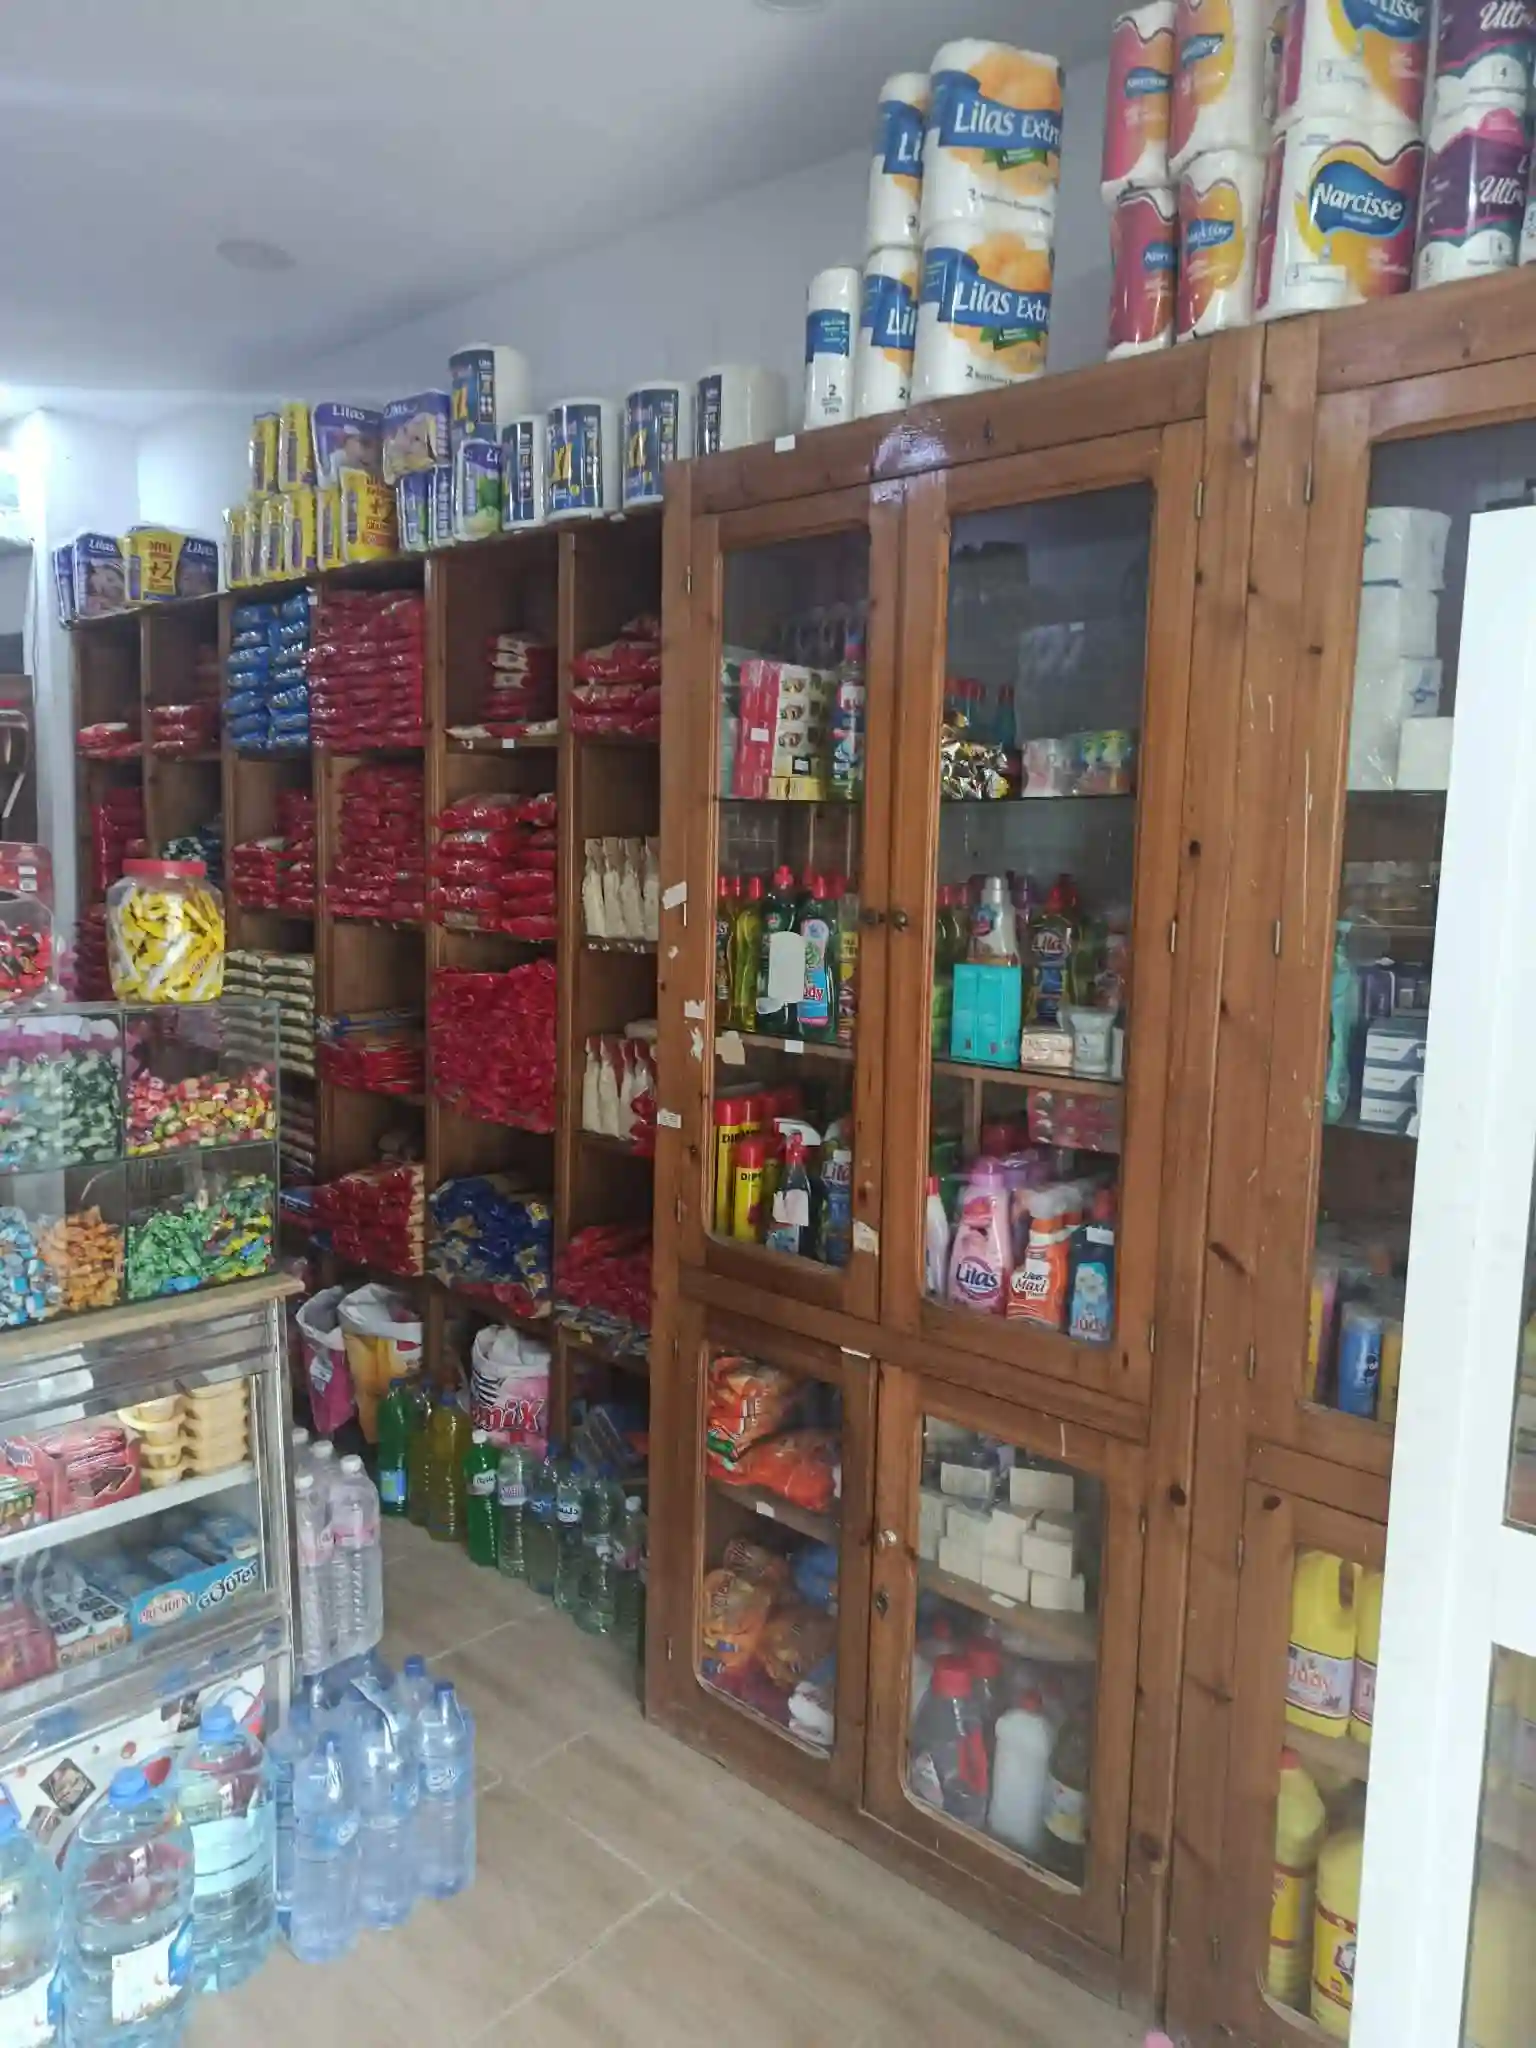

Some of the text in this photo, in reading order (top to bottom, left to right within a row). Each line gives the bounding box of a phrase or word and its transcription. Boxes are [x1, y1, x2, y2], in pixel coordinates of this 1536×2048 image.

[953, 100, 1061, 145] Lilas Extr
[1313, 182, 1403, 221] Narcisse
[952, 280, 1049, 322] Lilas Extr
[828, 383, 838, 397] 2
[332, 404, 366, 422] Lilas
[955, 1262, 999, 1289] Lilas
[1014, 1277, 1048, 1294] Maxi
